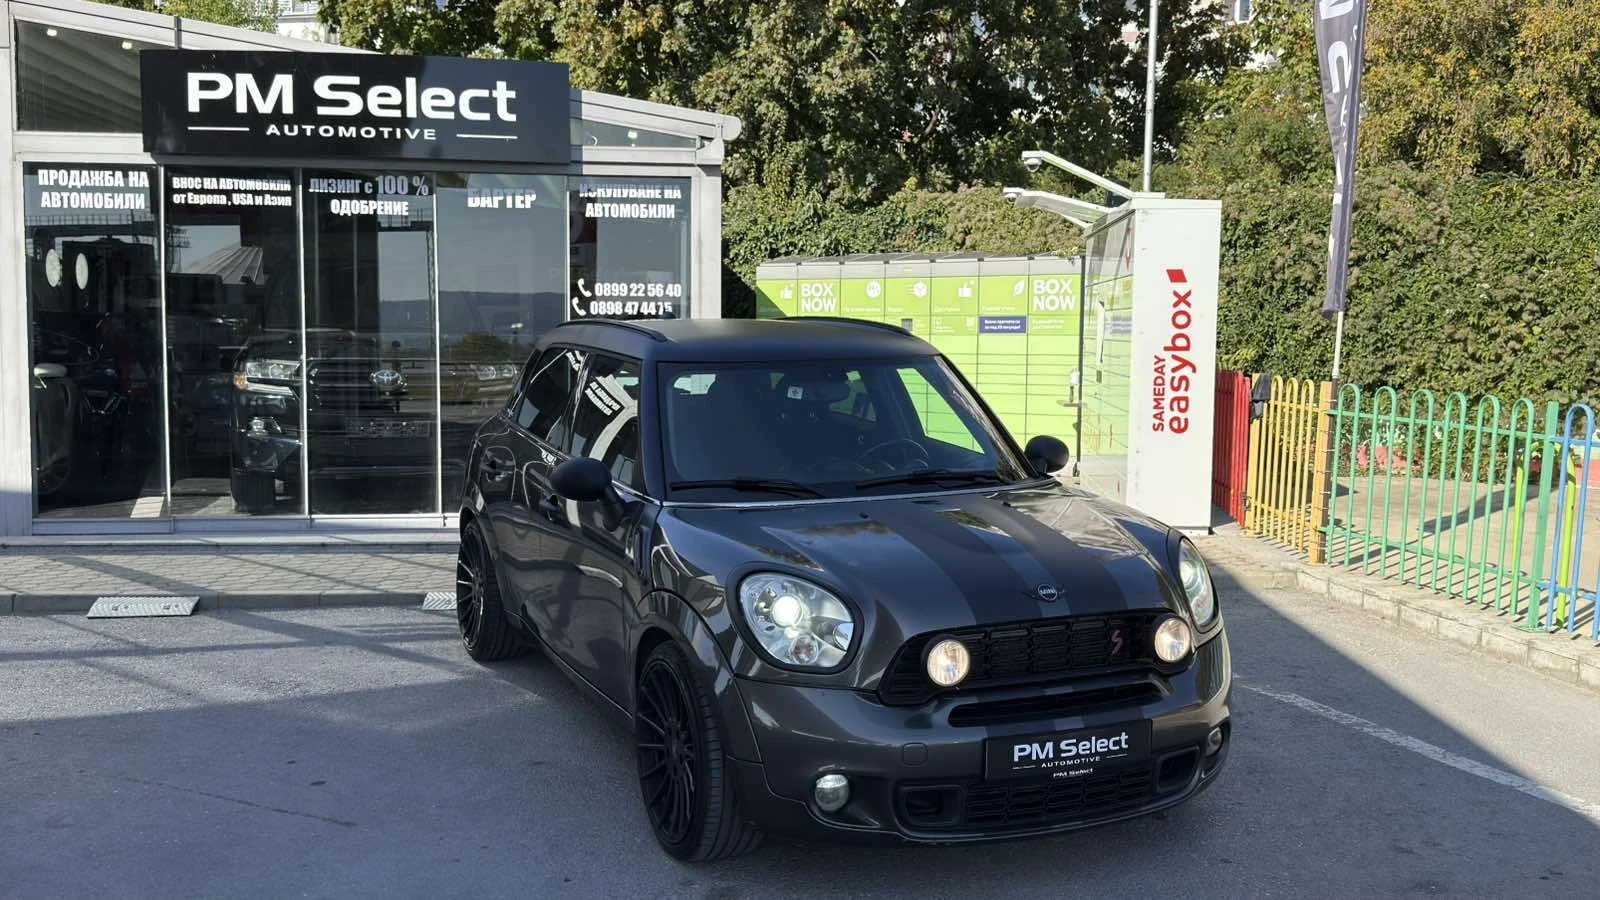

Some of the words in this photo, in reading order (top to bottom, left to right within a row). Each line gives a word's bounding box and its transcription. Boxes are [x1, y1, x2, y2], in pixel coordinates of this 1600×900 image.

[187, 72, 294, 115] PM
[313, 74, 517, 122] Select
[266, 123, 436, 140] AUTOMOTIVE
[38, 169, 123, 188] ПРОДАЖБА
[128, 171, 149, 188] НА
[172, 177, 202, 188] ВНОС
[203, 178, 218, 189] НА
[219, 178, 292, 190] АВТОМОБИЛИ
[309, 178, 362, 193] ЛИЗИНГ
[364, 181, 373, 193] с
[375, 175, 409, 195] 100
[412, 175, 429, 196] %
[467, 188, 537, 209] БАРТЕР
[664, 184, 682, 199] НА
[40, 191, 145, 210] АВТОМОБИЛИ
[173, 194, 187, 204] от
[233, 194, 253, 205] USA
[254, 195, 263, 206] и
[264, 195, 292, 206] Азия
[330, 199, 409, 216] ОДОБРЕНИЕ
[585, 203, 675, 219] АВТОМОБИЛИ
[594, 282, 628, 297] 0899
[629, 283, 645, 297] 22
[647, 283, 664, 297] 56
[665, 283, 682, 297] 40
[801, 283, 833, 297] BOX
[1033, 278, 1073, 294] BOX
[590, 300, 623, 315] 0898
[624, 301, 639, 315] 47
[640, 301, 657, 315] 44
[801, 298, 837, 312] NOW
[1033, 295, 1076, 311] NOW
[1163, 289, 1197, 434] easybox
[1152, 355, 1166, 432] SAMEDAY
[1013, 742, 1054, 762] PM
[1060, 732, 1129, 757] Select
[1041, 756, 1101, 768] AUTOMOTIVE
